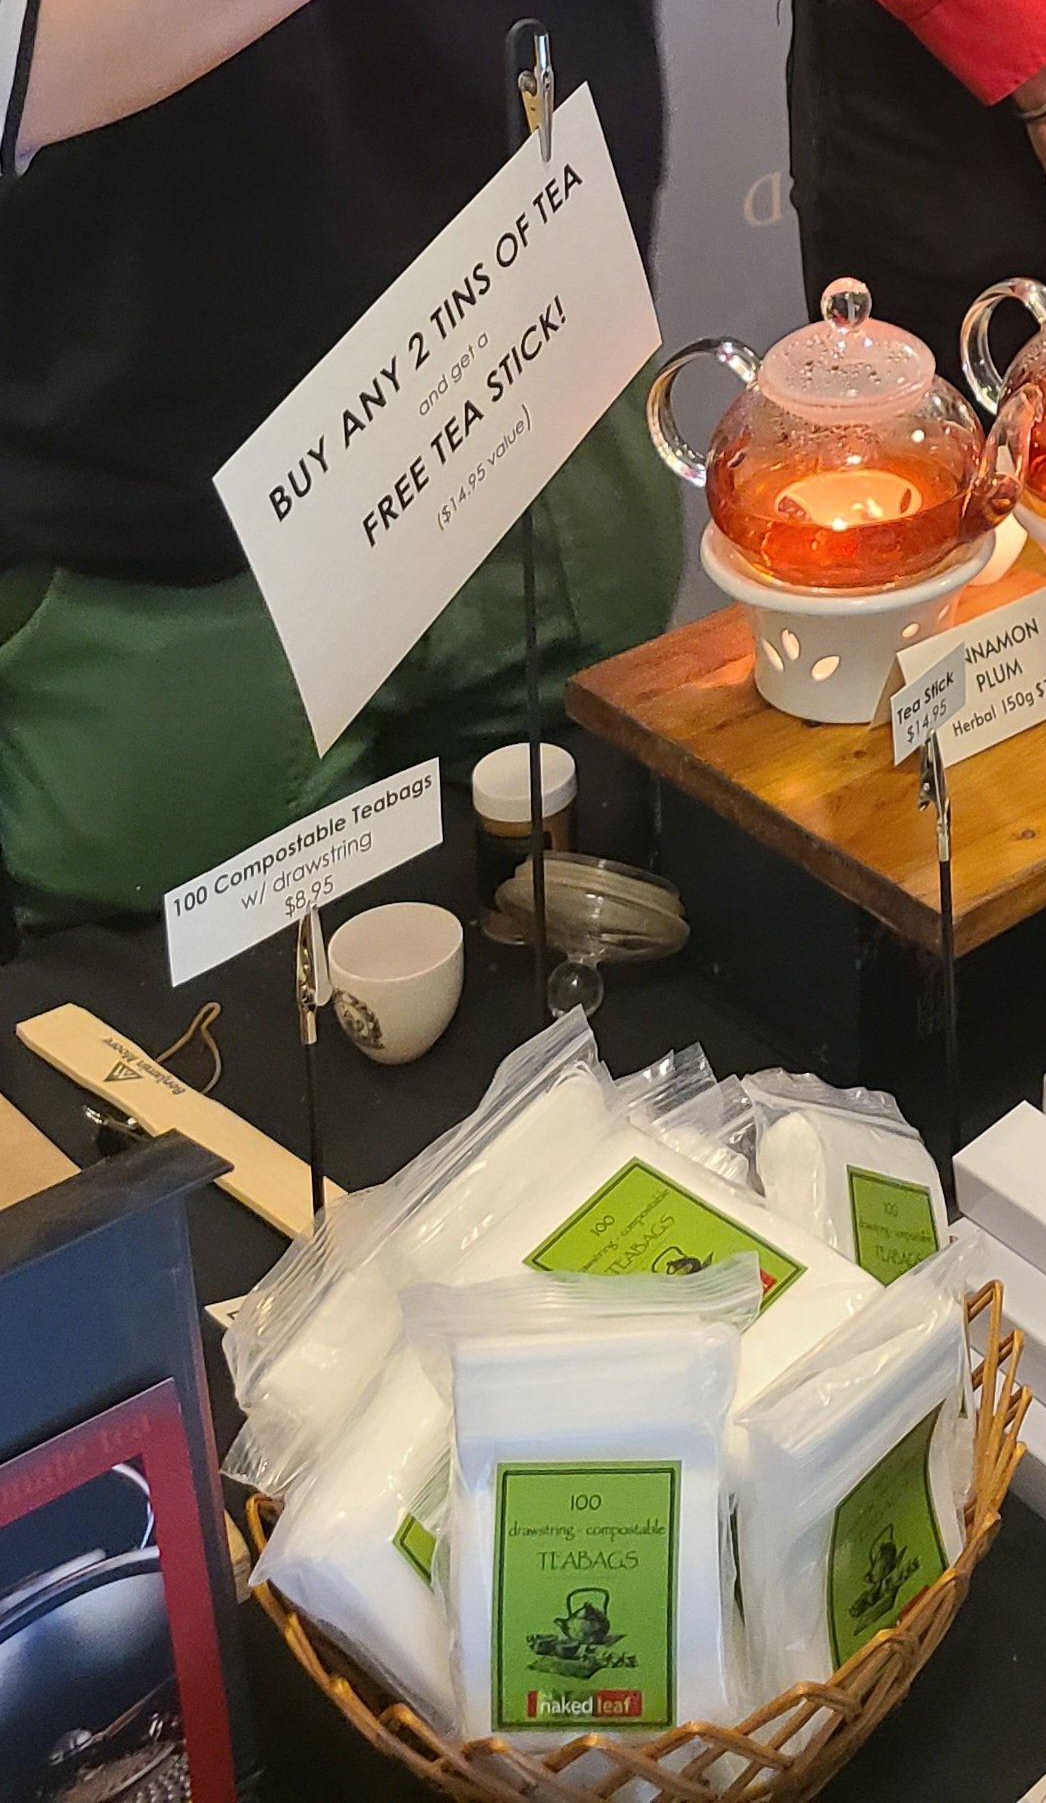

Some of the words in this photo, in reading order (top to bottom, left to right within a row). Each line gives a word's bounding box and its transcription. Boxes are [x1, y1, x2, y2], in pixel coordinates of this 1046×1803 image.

[269, 434, 328, 523] BUY
[342, 354, 400, 449] ANY
[408, 331, 431, 371] 2
[430, 262, 491, 340] TINS
[496, 212, 529, 268] OF
[533, 163, 583, 225] TEA
[419, 374, 448, 416] and
[451, 344, 475, 384] get
[478, 331, 489, 349] a
[362, 455, 429, 548] FREE
[430, 399, 484, 465] TEA
[487, 294, 566, 403] STICK!
[437, 463, 486, 531] ($14.95
[487, 403, 532, 466] value)
[965, 617, 1039, 664] NNAMON
[897, 701, 920, 725] Tea
[924, 671, 954, 704] Stick
[976, 658, 1023, 693] PLUM
[906, 700, 947, 743] $14.95
[952, 704, 997, 737] Herbal
[1002, 692, 1035, 714] 150g
[173, 886, 207, 917] 100
[213, 817, 346, 895] Compostable
[351, 774, 432, 824] Teabags
[240, 884, 266, 910] w/
[272, 831, 373, 892] drawstring
[284, 875, 334, 918] $8.95
[590, 1215, 616, 1237] 100
[570, 1494, 602, 1512] 100
[508, 1520, 576, 1541] drawstring
[585, 1517, 666, 1542] compostable
[537, 1550, 639, 1570] TEABAGS
[539, 1695, 593, 1714] naked
[596, 1696, 632, 1714] leaf
